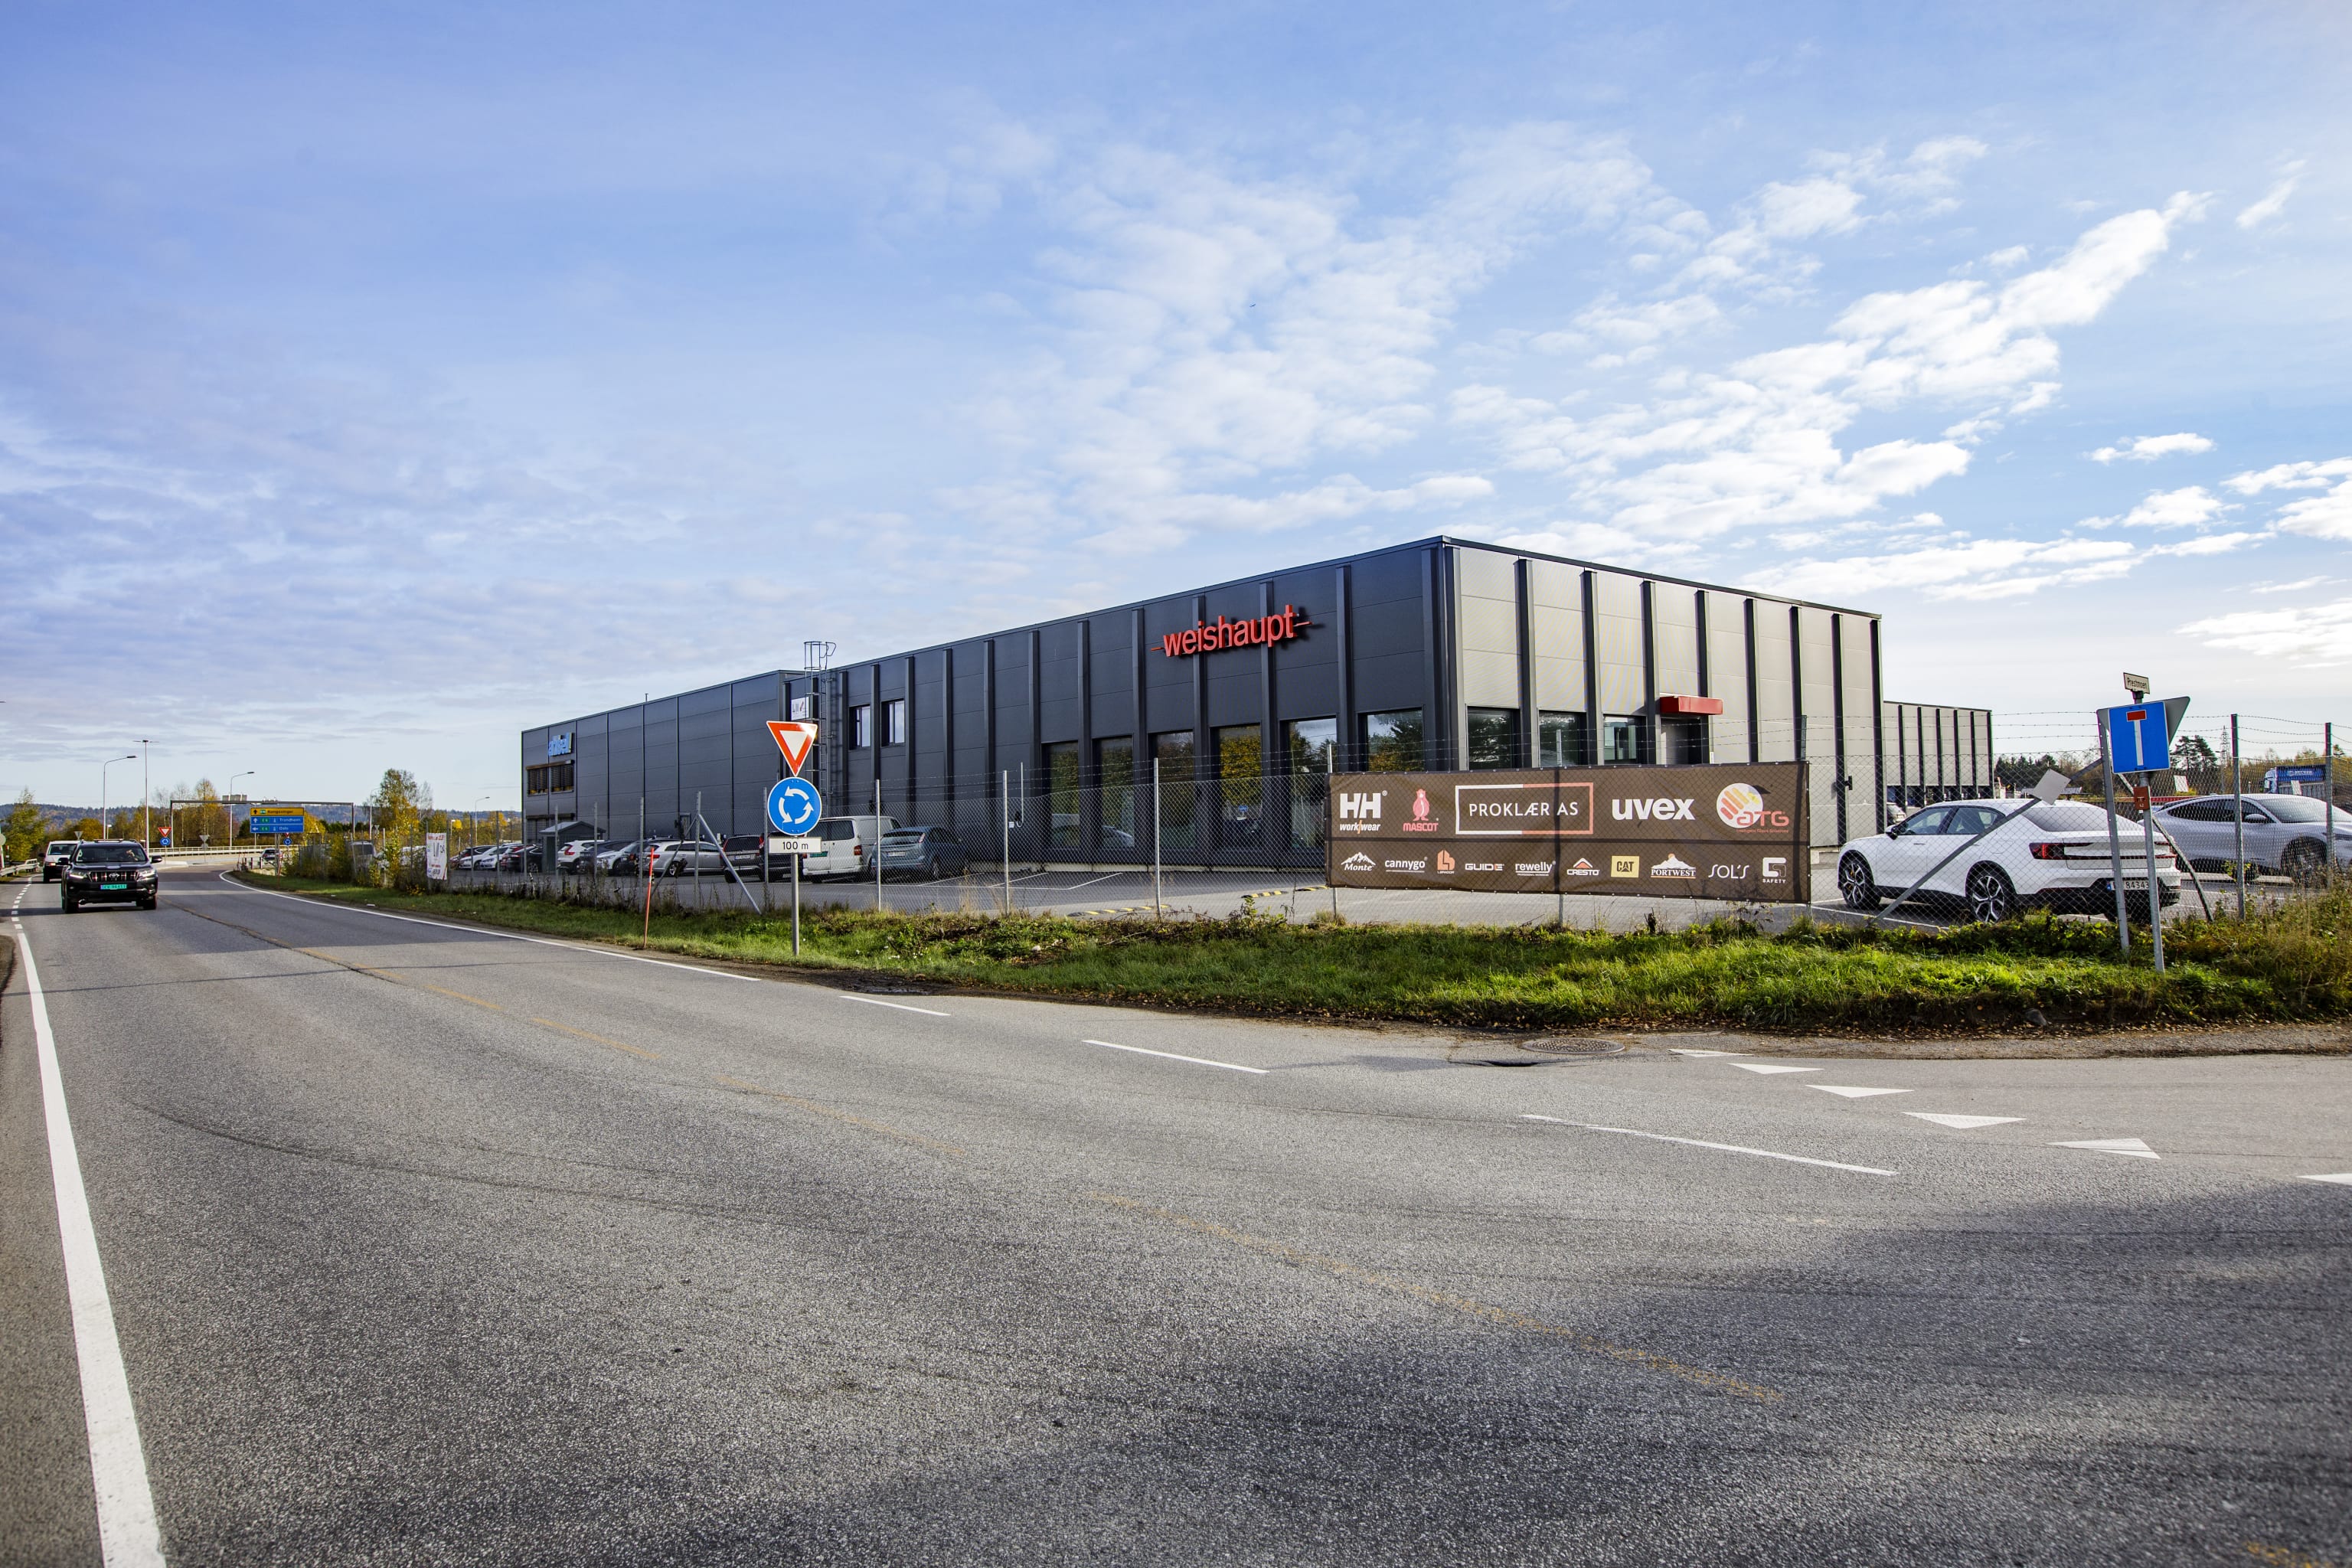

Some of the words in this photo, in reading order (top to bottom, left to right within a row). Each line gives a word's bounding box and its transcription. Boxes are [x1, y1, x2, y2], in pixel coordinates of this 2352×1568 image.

[1162, 604, 1297, 657] weishaupt
[1468, 802, 1550, 817] PROKLÆR
[1557, 802, 1579, 816] AS
[1612, 798, 1696, 821] uvex
[1403, 822, 1439, 831] MASCOT
[782, 841, 799, 850] 100
[1344, 863, 1374, 871] Monte
[1384, 859, 1426, 871] cannygo
[1465, 863, 1504, 871] GUIDE
[1515, 861, 1553, 873] rewelly
[1616, 861, 1635, 873] CAT
[1651, 868, 1696, 877] PORTWEST
[1708, 864, 1749, 879] SOL'S
